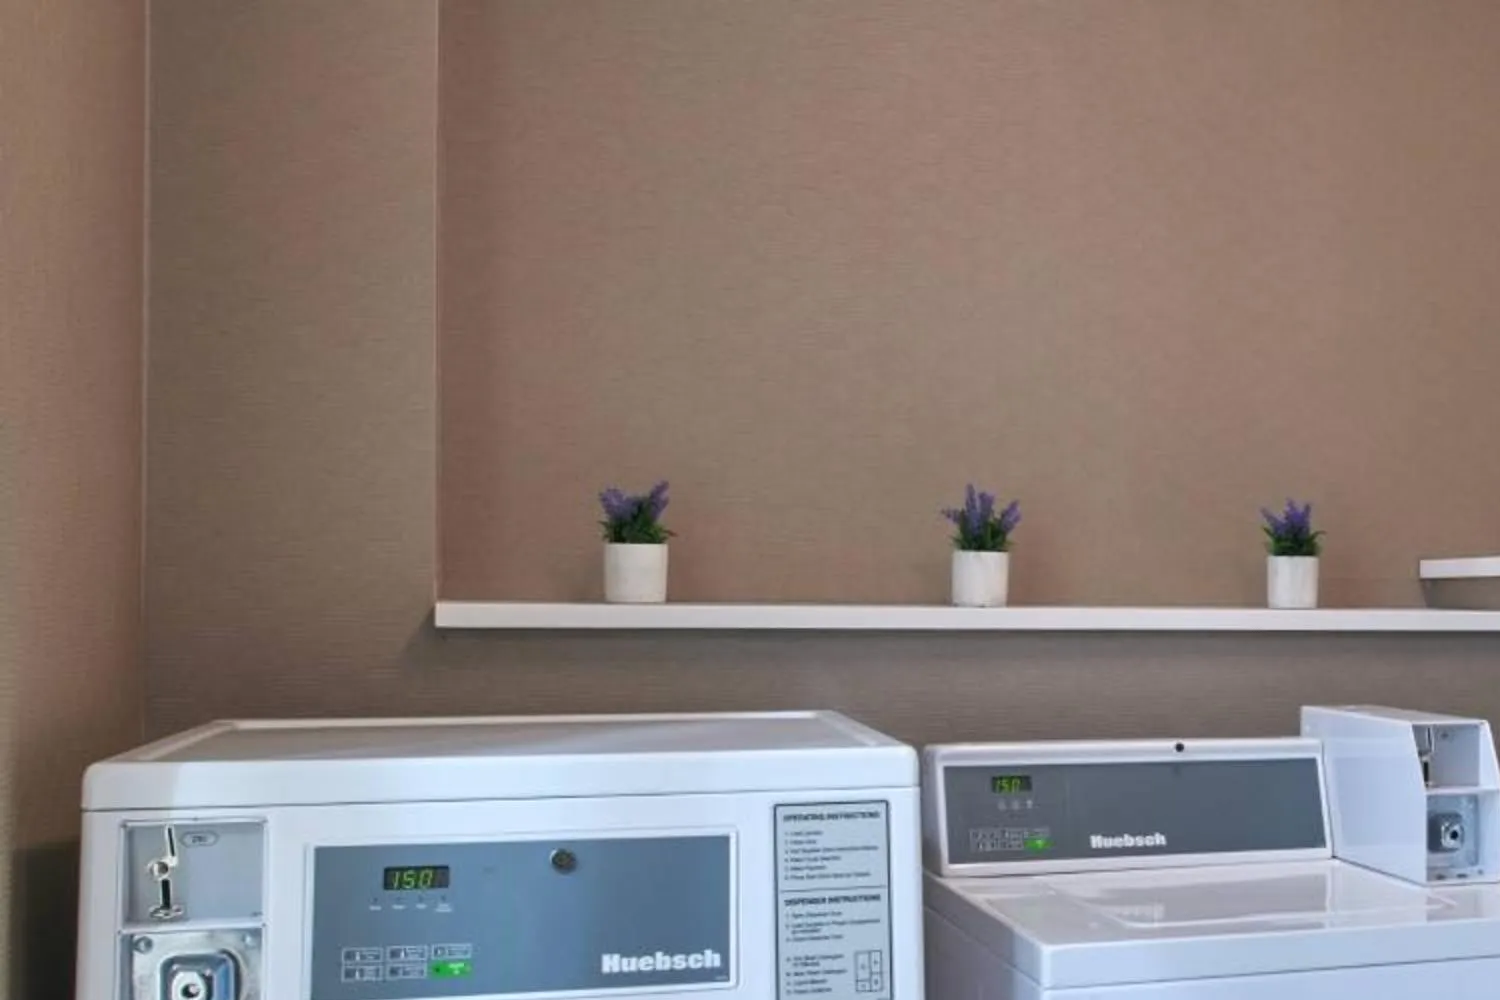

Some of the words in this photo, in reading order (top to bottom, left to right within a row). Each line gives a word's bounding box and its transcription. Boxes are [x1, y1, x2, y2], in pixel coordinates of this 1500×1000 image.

[1089, 832, 1167, 849] Huebsch
[392, 869, 433, 889] 150
[601, 948, 721, 974] Huebsch
